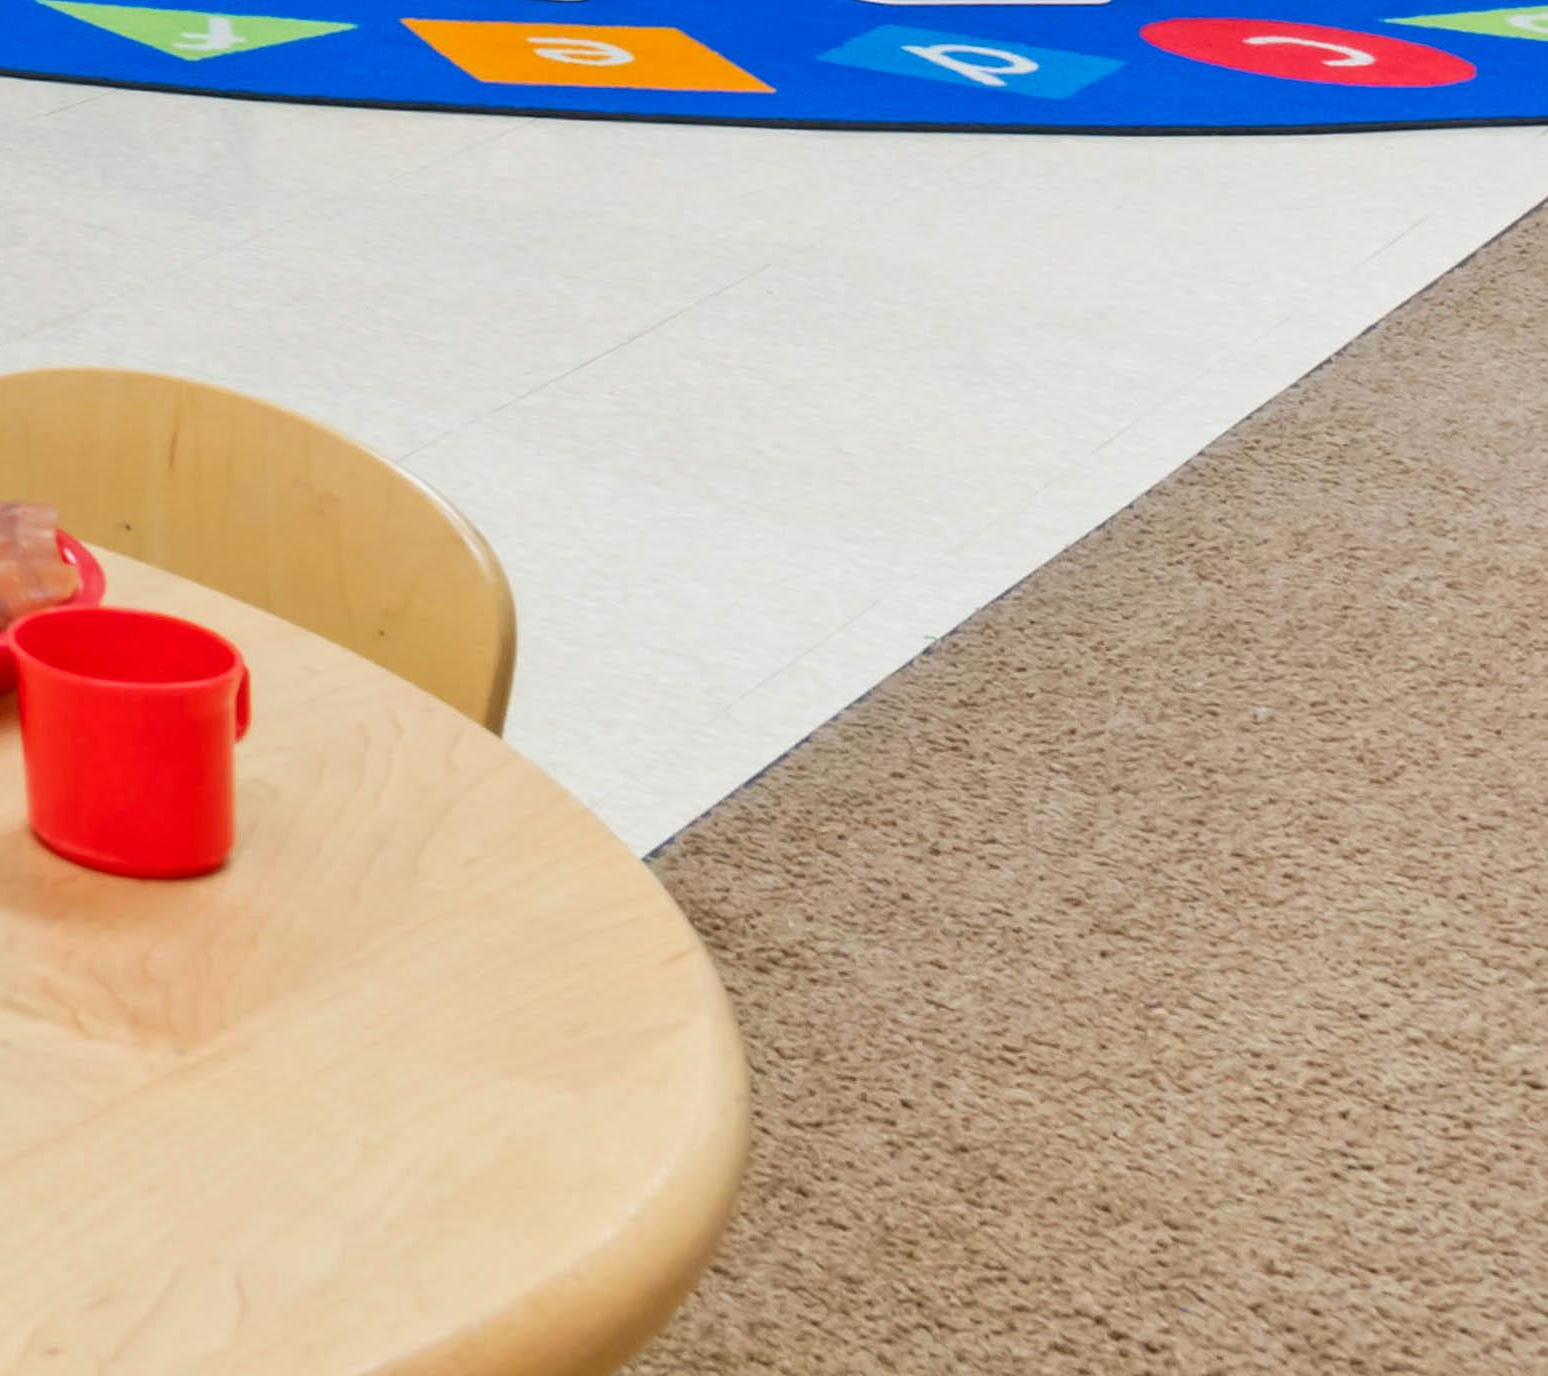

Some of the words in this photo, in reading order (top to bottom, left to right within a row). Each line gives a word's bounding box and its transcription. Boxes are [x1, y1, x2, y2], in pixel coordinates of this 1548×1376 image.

[173, 14, 246, 50] f
[527, 36, 635, 67] e
[1242, 36, 1375, 67] c
